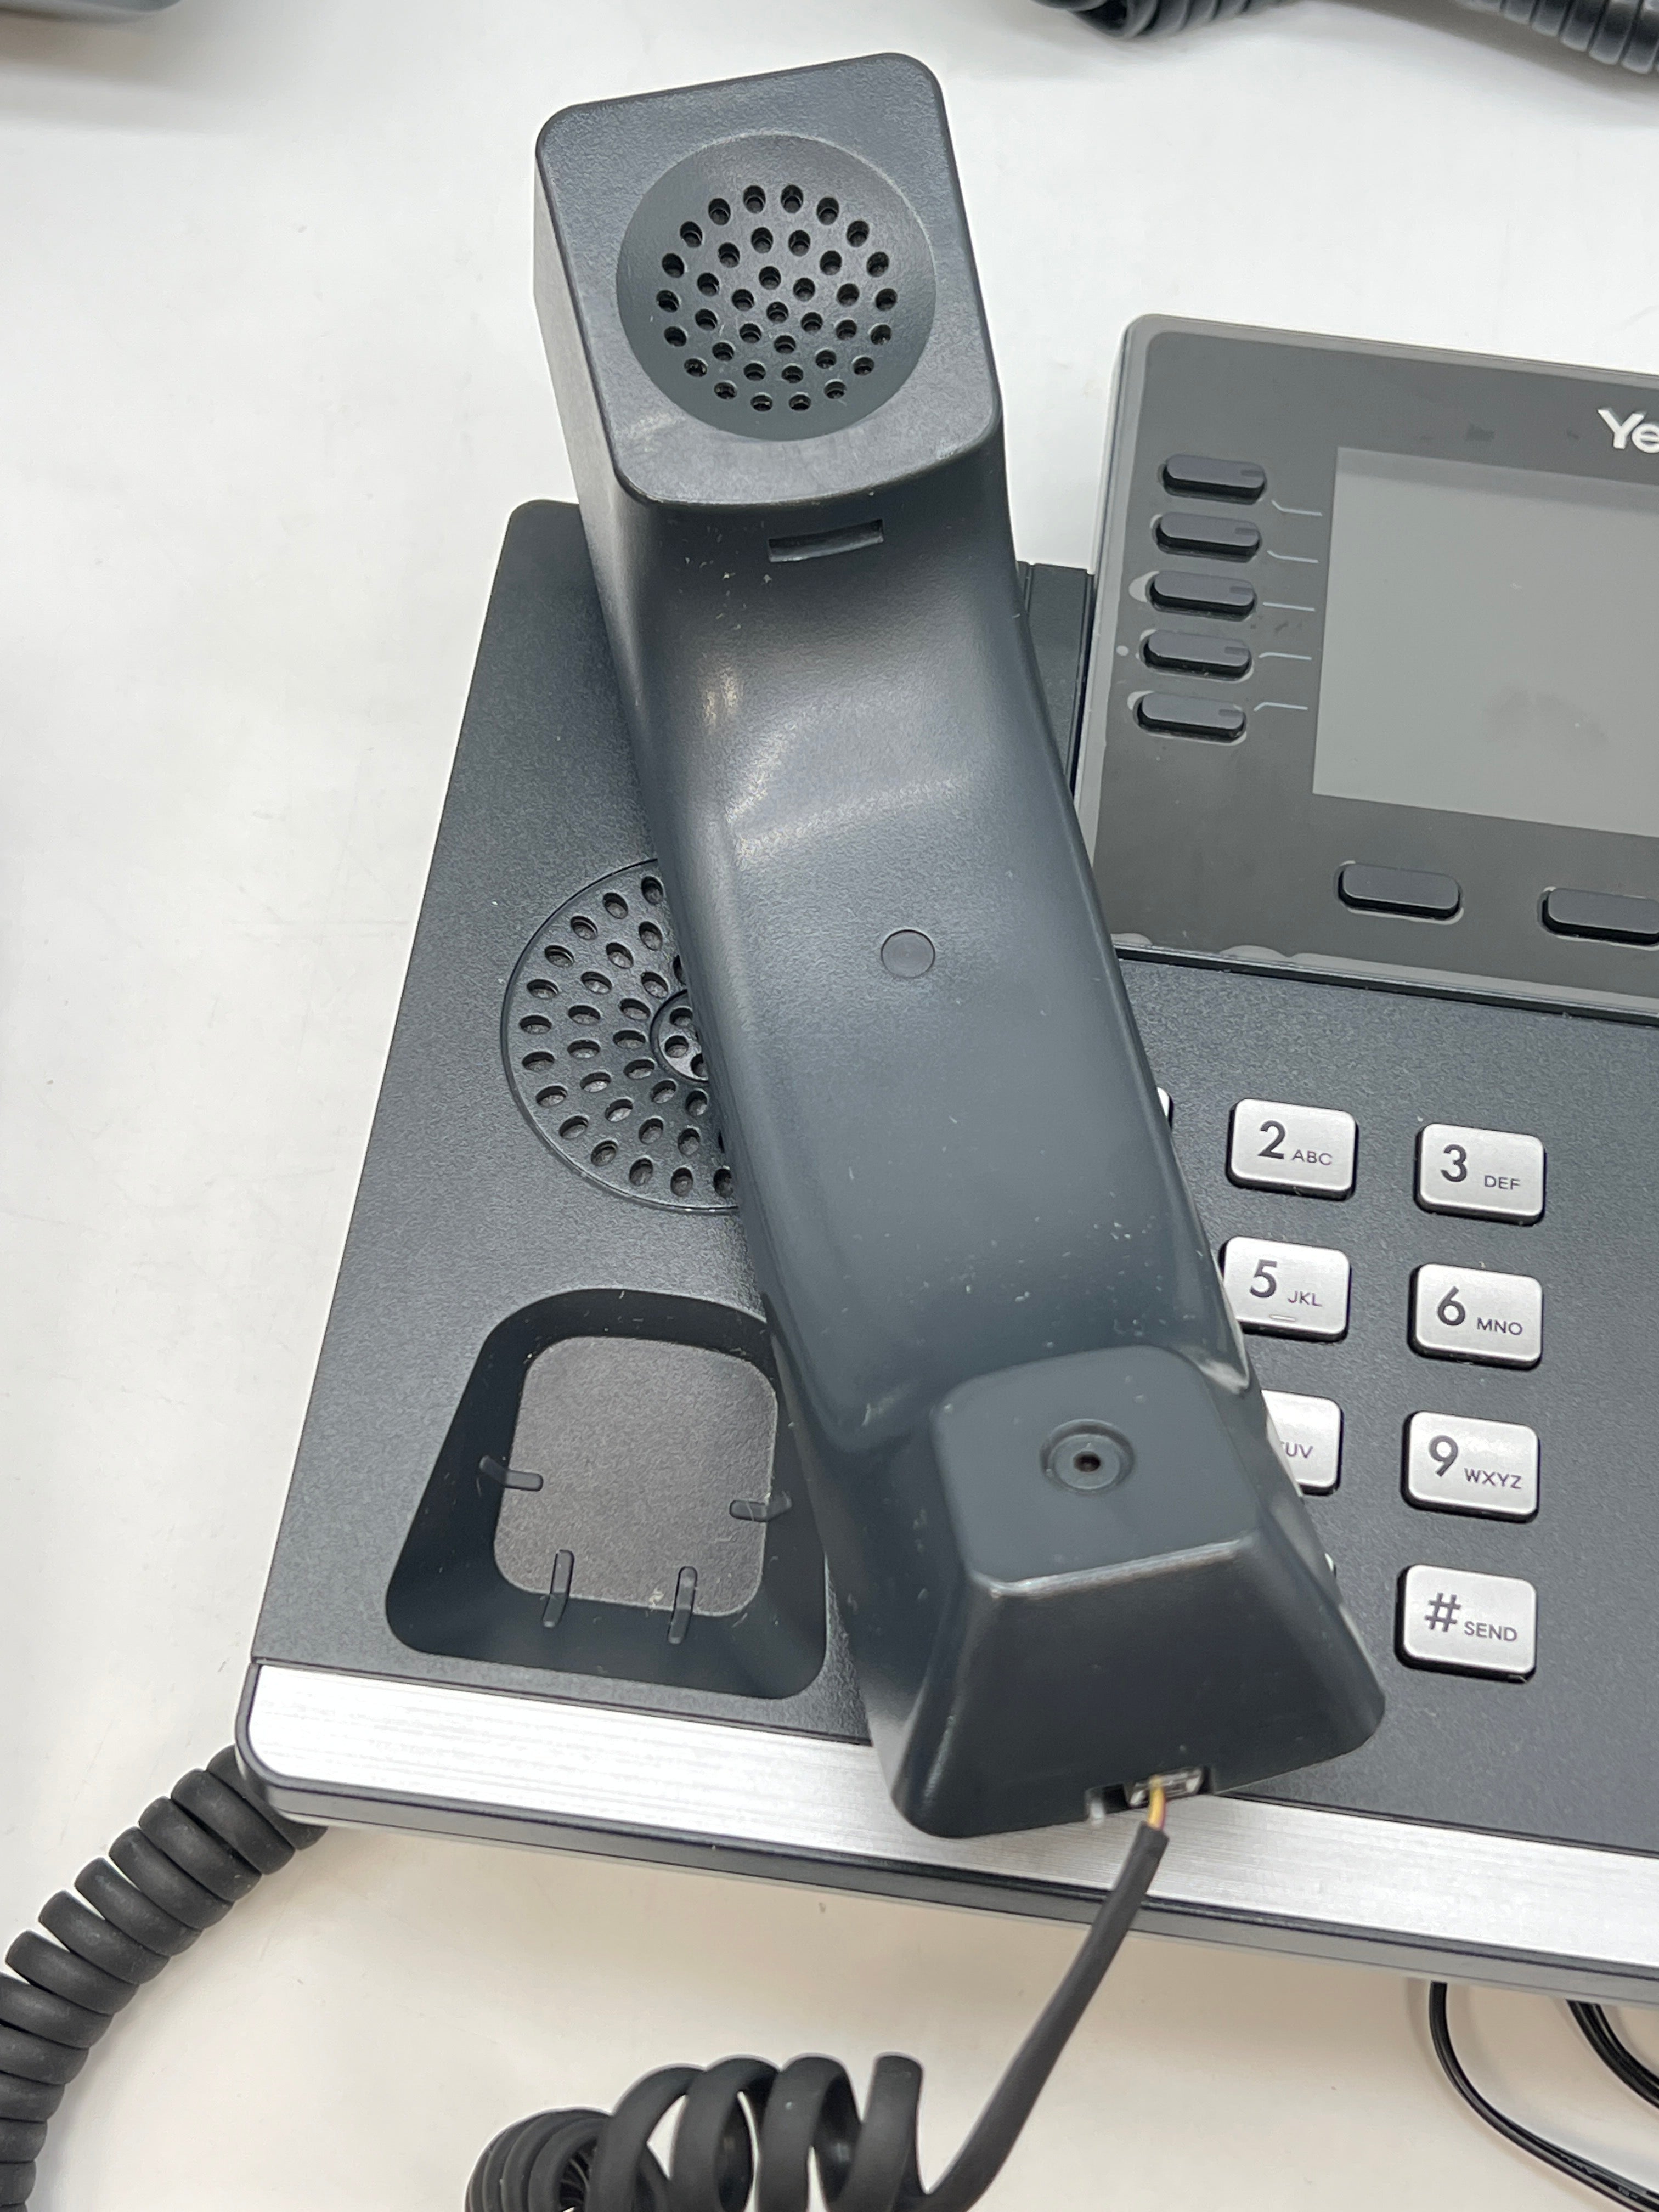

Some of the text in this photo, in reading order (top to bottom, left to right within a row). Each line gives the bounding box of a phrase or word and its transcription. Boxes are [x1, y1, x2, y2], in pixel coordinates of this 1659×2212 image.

[1257, 1121, 1333, 1166] 2 ABC
[1441, 1144, 1520, 1190] 3 DEF
[1250, 1260, 1322, 1307] 5 JKL
[1437, 1287, 1523, 1336] 6 MNO
[1429, 1435, 1522, 1489] 9 WXYZ
[1464, 1621, 1518, 1642] SEND
